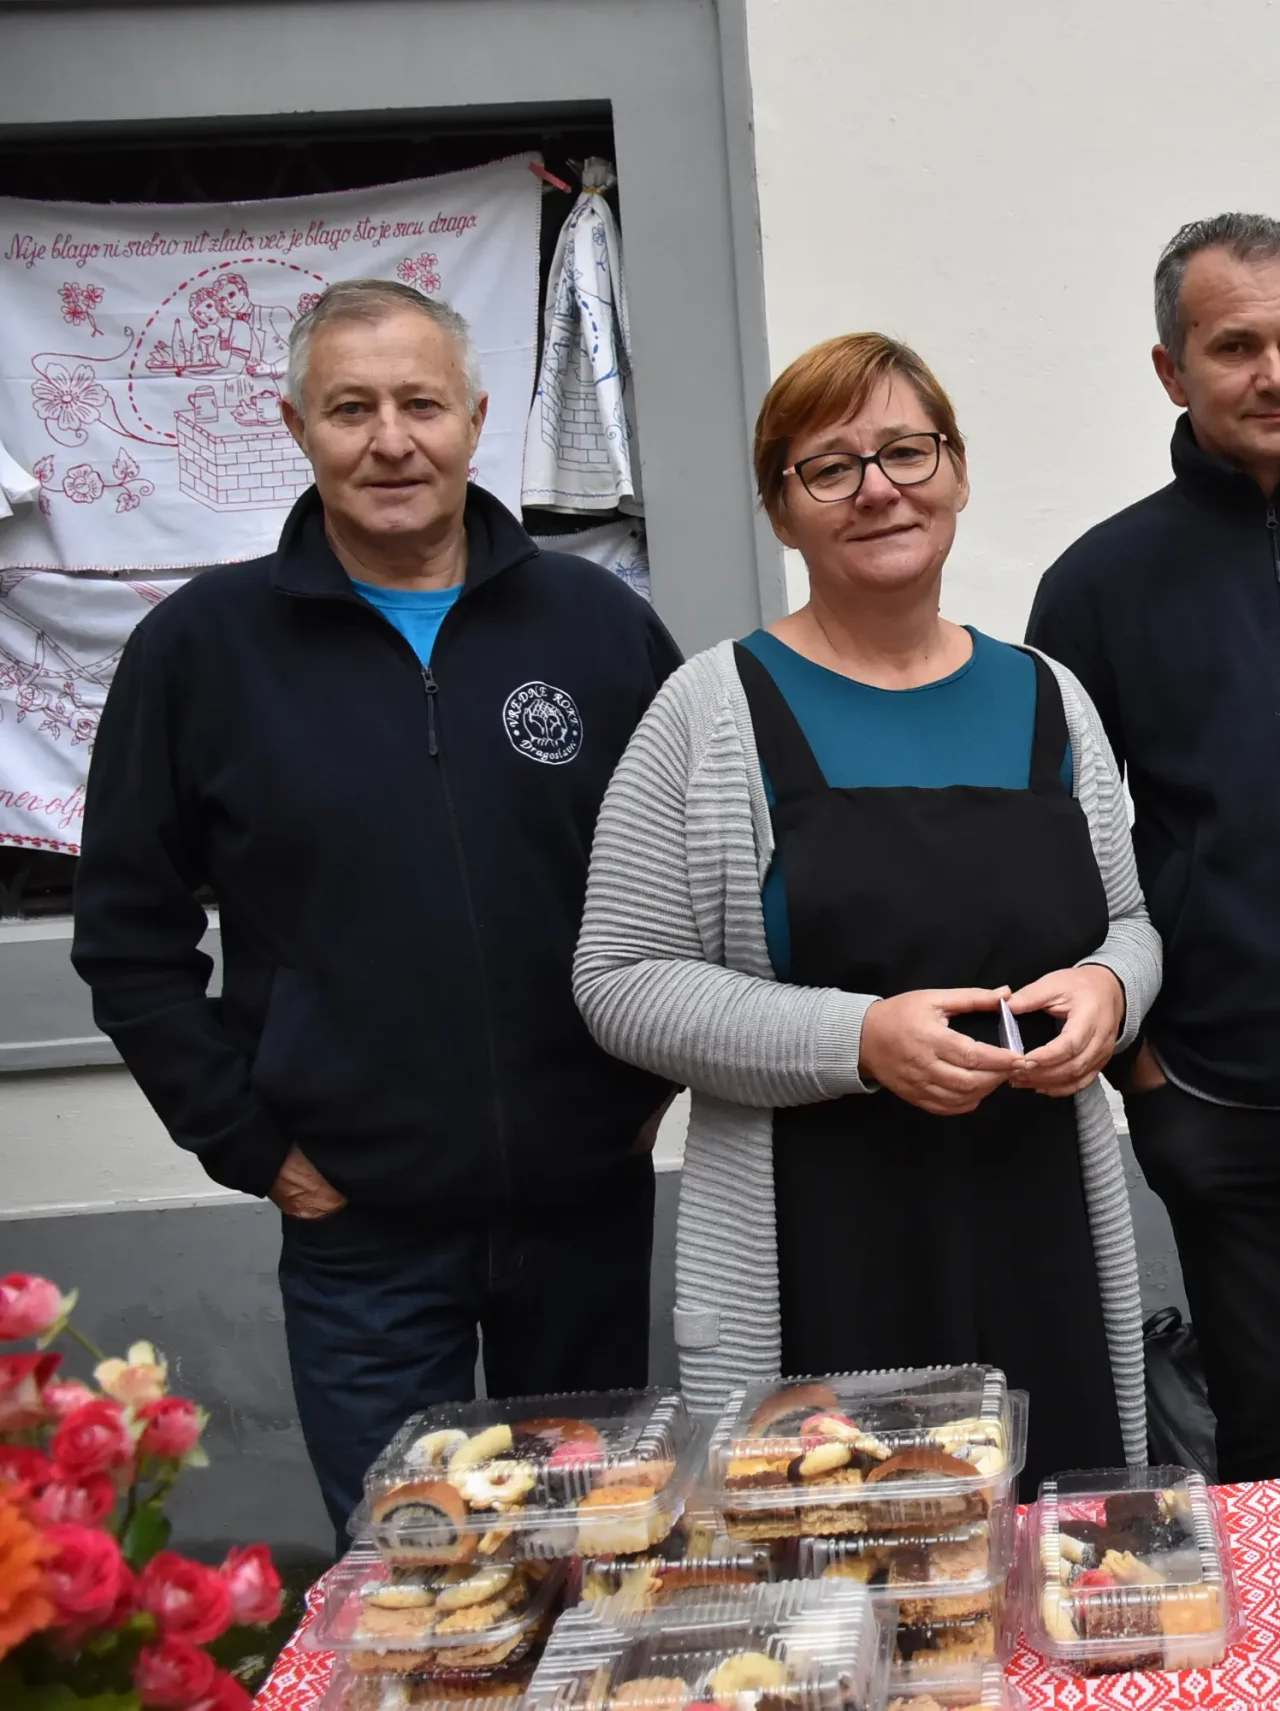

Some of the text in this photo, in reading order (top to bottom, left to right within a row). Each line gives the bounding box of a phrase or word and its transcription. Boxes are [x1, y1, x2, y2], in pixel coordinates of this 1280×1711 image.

[4, 232, 47, 269] Nije
[51, 233, 101, 268] blago
[103, 239, 122, 258] ni
[122, 231, 180, 259] srebro
[282, 228, 304, 255] je
[304, 220, 352, 251] blago
[372, 220, 391, 248] je
[506, 685, 548, 728] VREDNE
